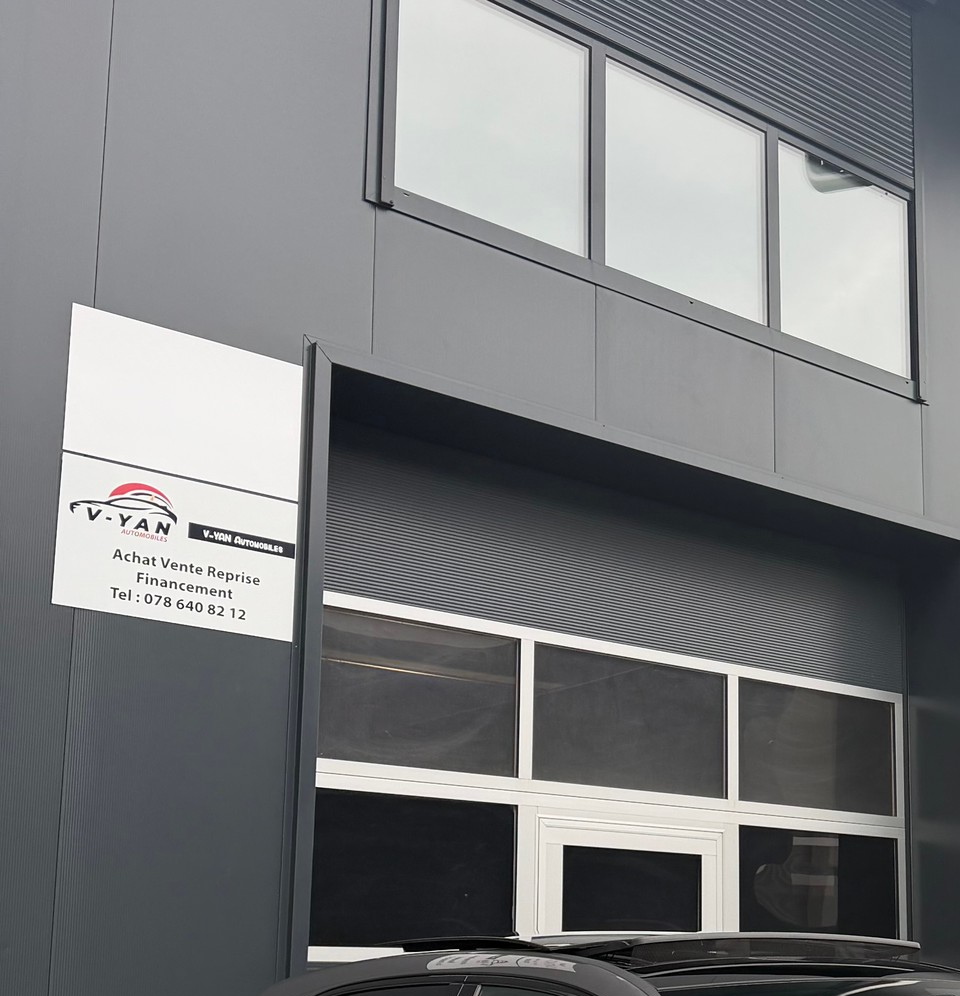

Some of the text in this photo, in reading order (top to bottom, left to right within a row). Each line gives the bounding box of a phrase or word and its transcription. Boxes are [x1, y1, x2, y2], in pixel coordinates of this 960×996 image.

[86, 506, 171, 536] V-YAN
[120, 528, 168, 543] AUTOMOBILES
[202, 529, 232, 543] V-YAN
[112, 548, 261, 586] Achat Vente Reprise
[136, 572, 233, 600] Financement
[144, 593, 172, 608] 078
[176, 599, 204, 613] 640
[207, 603, 226, 617] 82
[230, 607, 246, 620] 12
